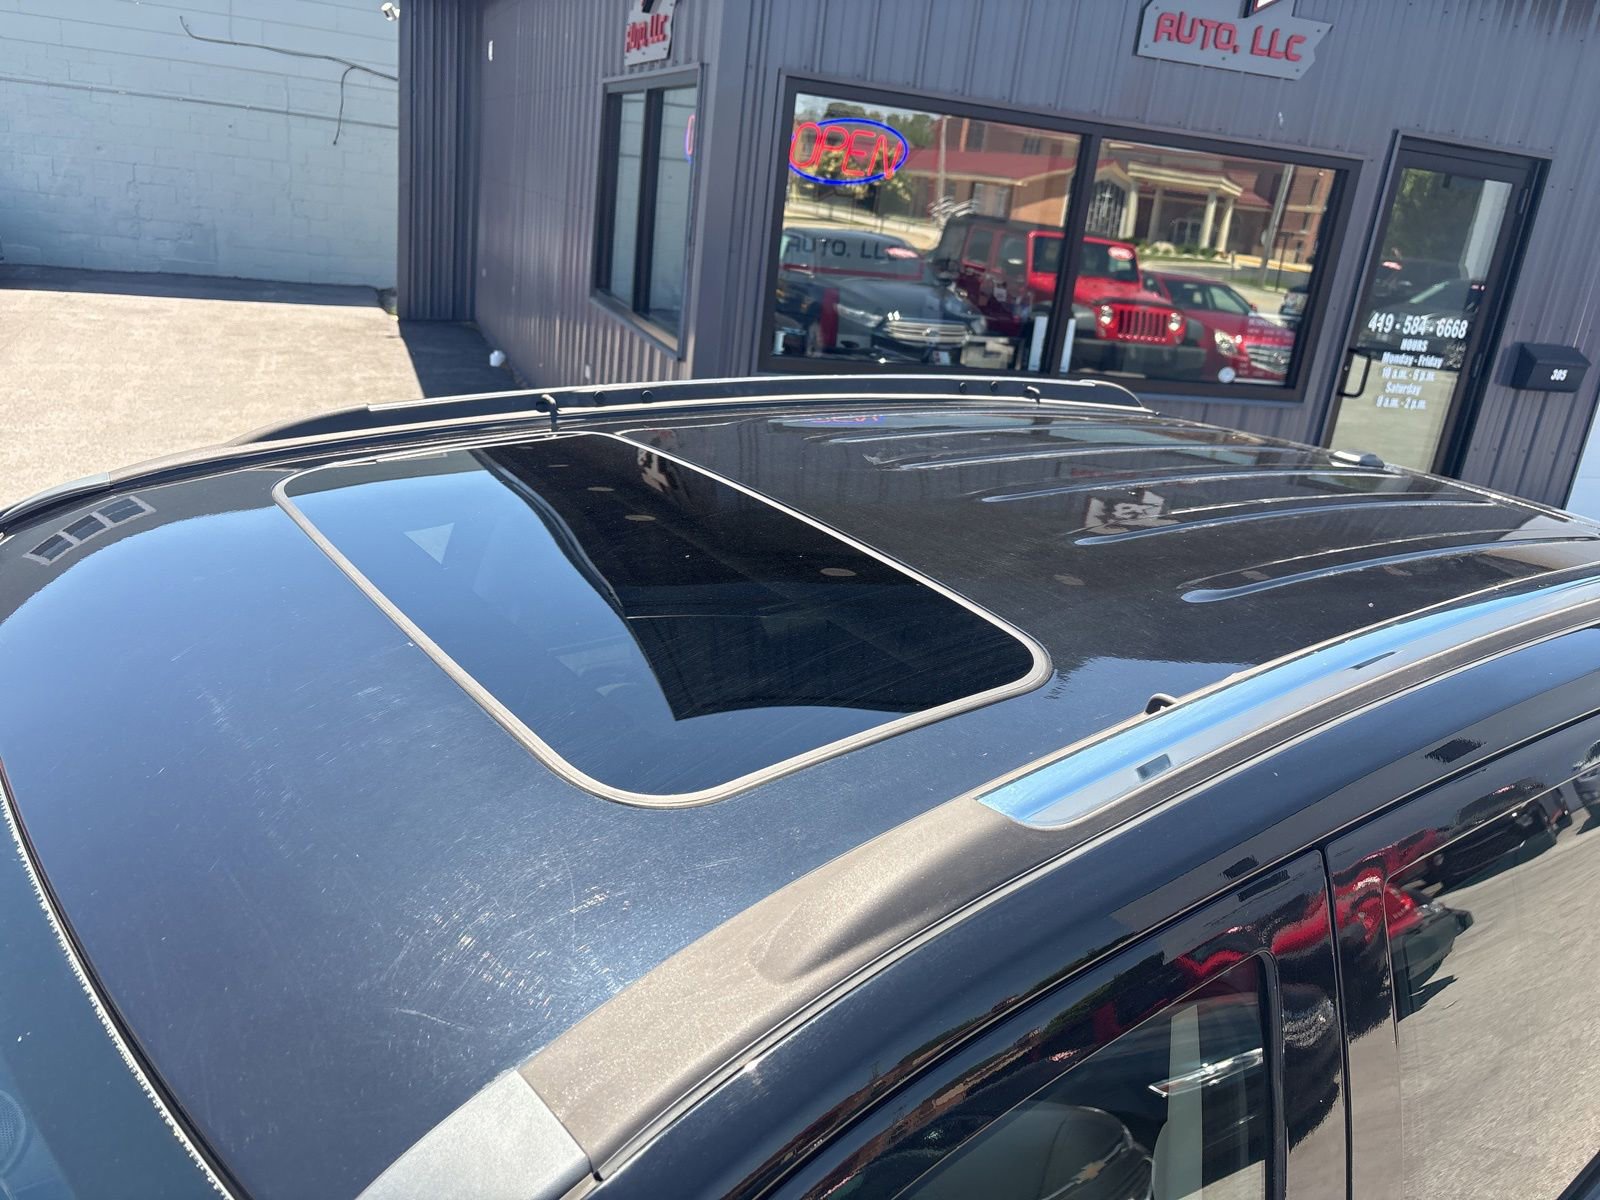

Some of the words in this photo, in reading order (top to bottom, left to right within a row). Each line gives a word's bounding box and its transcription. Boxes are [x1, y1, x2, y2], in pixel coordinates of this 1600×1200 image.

[1153, 11, 1240, 54] AUTO,
[1250, 25, 1307, 62] LLC
[789, 121, 902, 180] OPEN
[1402, 315, 1428, 336] 584
[1436, 317, 1468, 339] 6668
[1400, 338, 1429, 352] HOURS
[1381, 351, 1415, 367] Monday
[1417, 354, 1444, 369] Friday
[1385, 381, 1423, 397] Saturday
